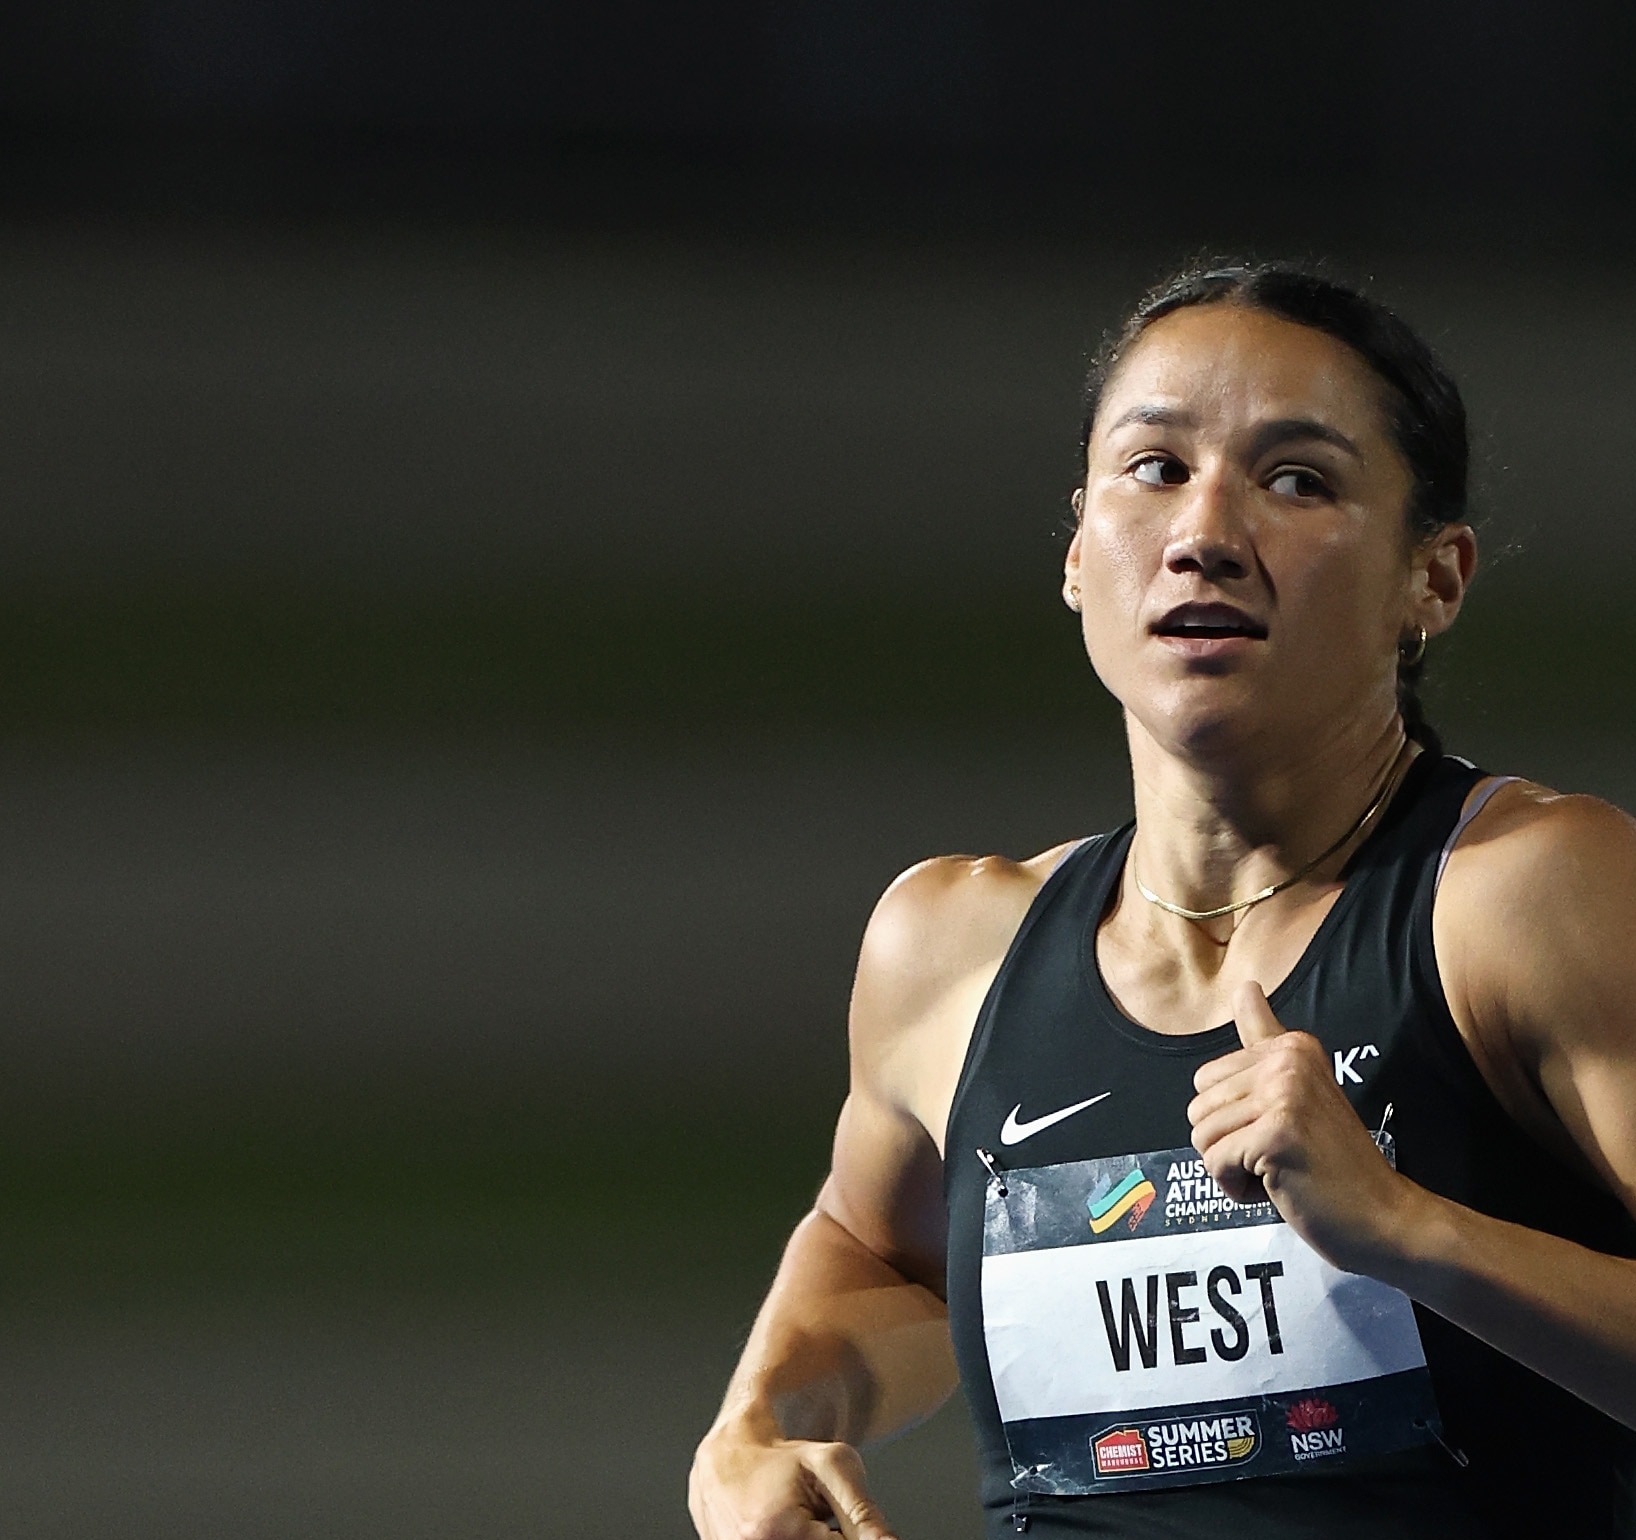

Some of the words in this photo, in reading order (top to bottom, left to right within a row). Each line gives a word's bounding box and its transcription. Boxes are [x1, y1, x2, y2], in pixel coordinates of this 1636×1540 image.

[1166, 1159, 1213, 1182] AUS
[1165, 1177, 1230, 1203] ATHL
[1245, 1207, 1273, 1218] 202
[1095, 1260, 1285, 1373] WEST
[1147, 1415, 1256, 1448] SUMMER
[1290, 1427, 1344, 1454] NSW
[1099, 1443, 1143, 1460] CHEMIST
[1151, 1440, 1229, 1468] SERIES
